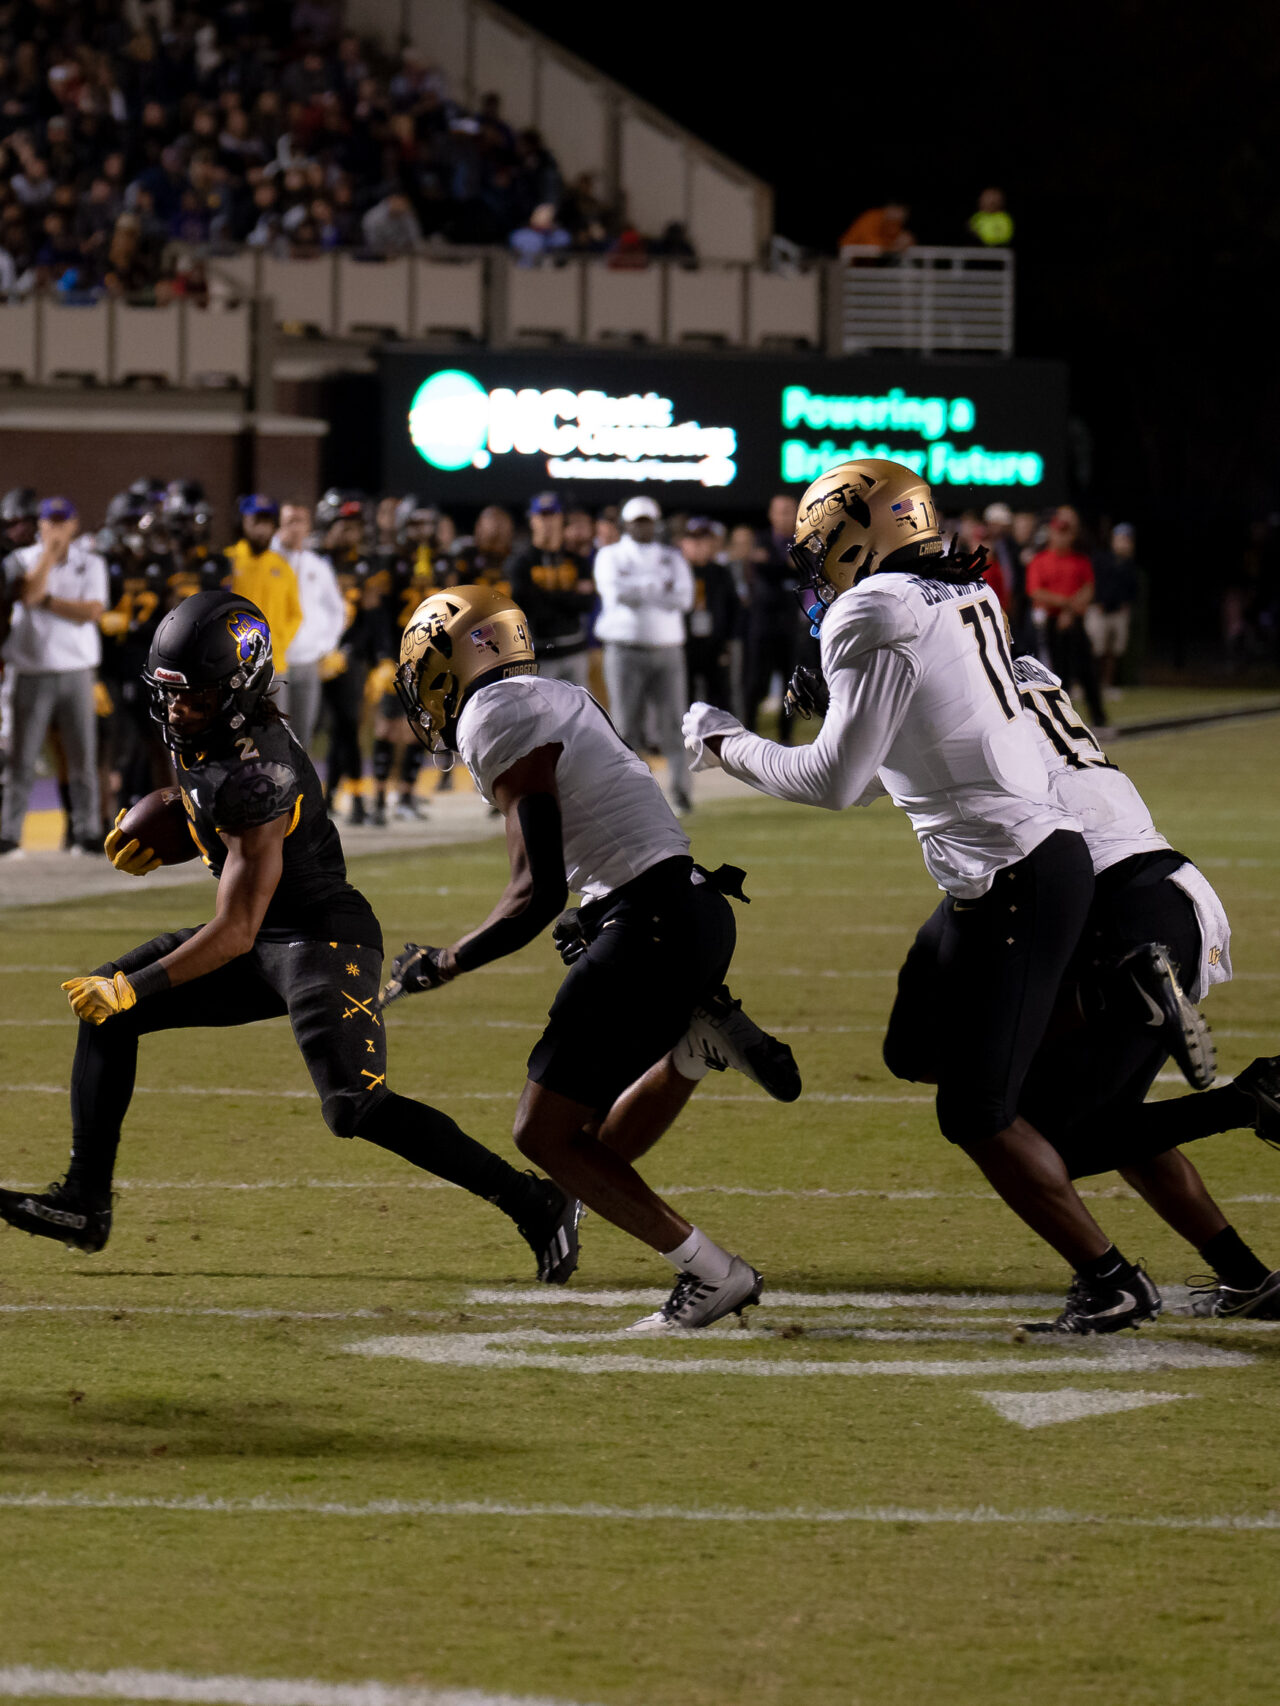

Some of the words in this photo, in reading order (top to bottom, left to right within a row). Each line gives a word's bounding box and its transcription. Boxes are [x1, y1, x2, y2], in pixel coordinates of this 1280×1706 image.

[782, 385, 946, 440] Powering
[947, 397, 976, 432] a
[927, 441, 1043, 486] Future
[807, 483, 862, 528] UCF
[957, 597, 1024, 722] 11
[234, 737, 260, 761] 2
